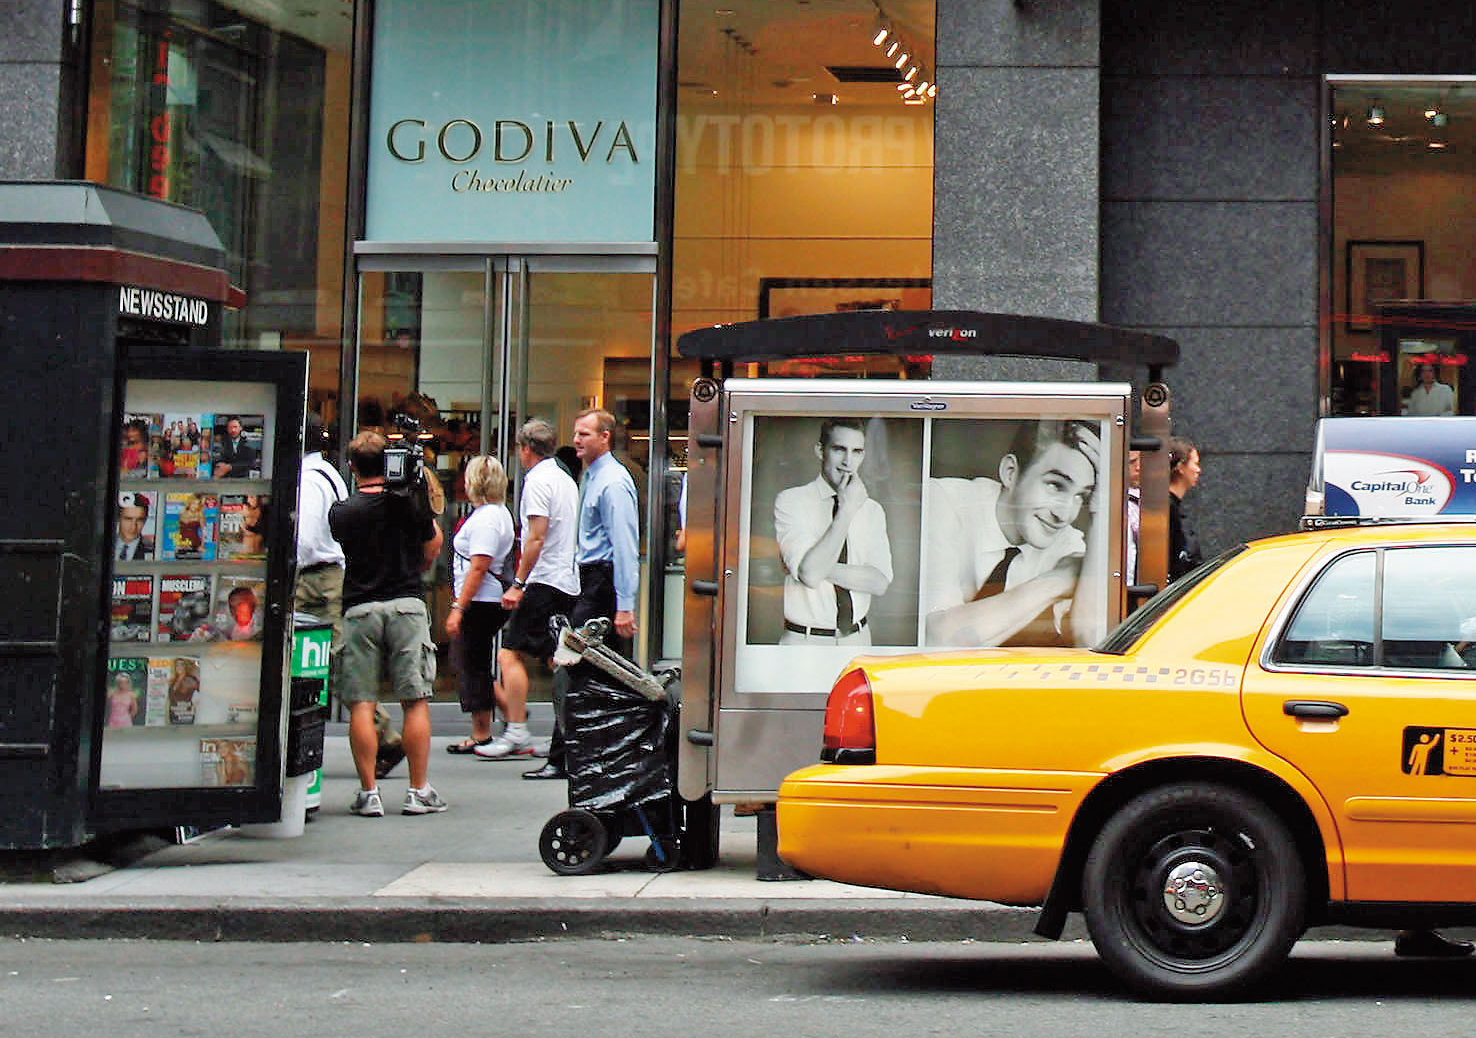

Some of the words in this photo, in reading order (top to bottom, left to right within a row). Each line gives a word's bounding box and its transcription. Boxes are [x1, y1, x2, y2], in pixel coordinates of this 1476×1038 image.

[387, 118, 639, 164] GODIVA
[451, 169, 575, 194] Chocolatier
[119, 286, 208, 326] NEWSSTAND
[929, 327, 977, 342] verizon
[1405, 497, 1436, 505] Bank
